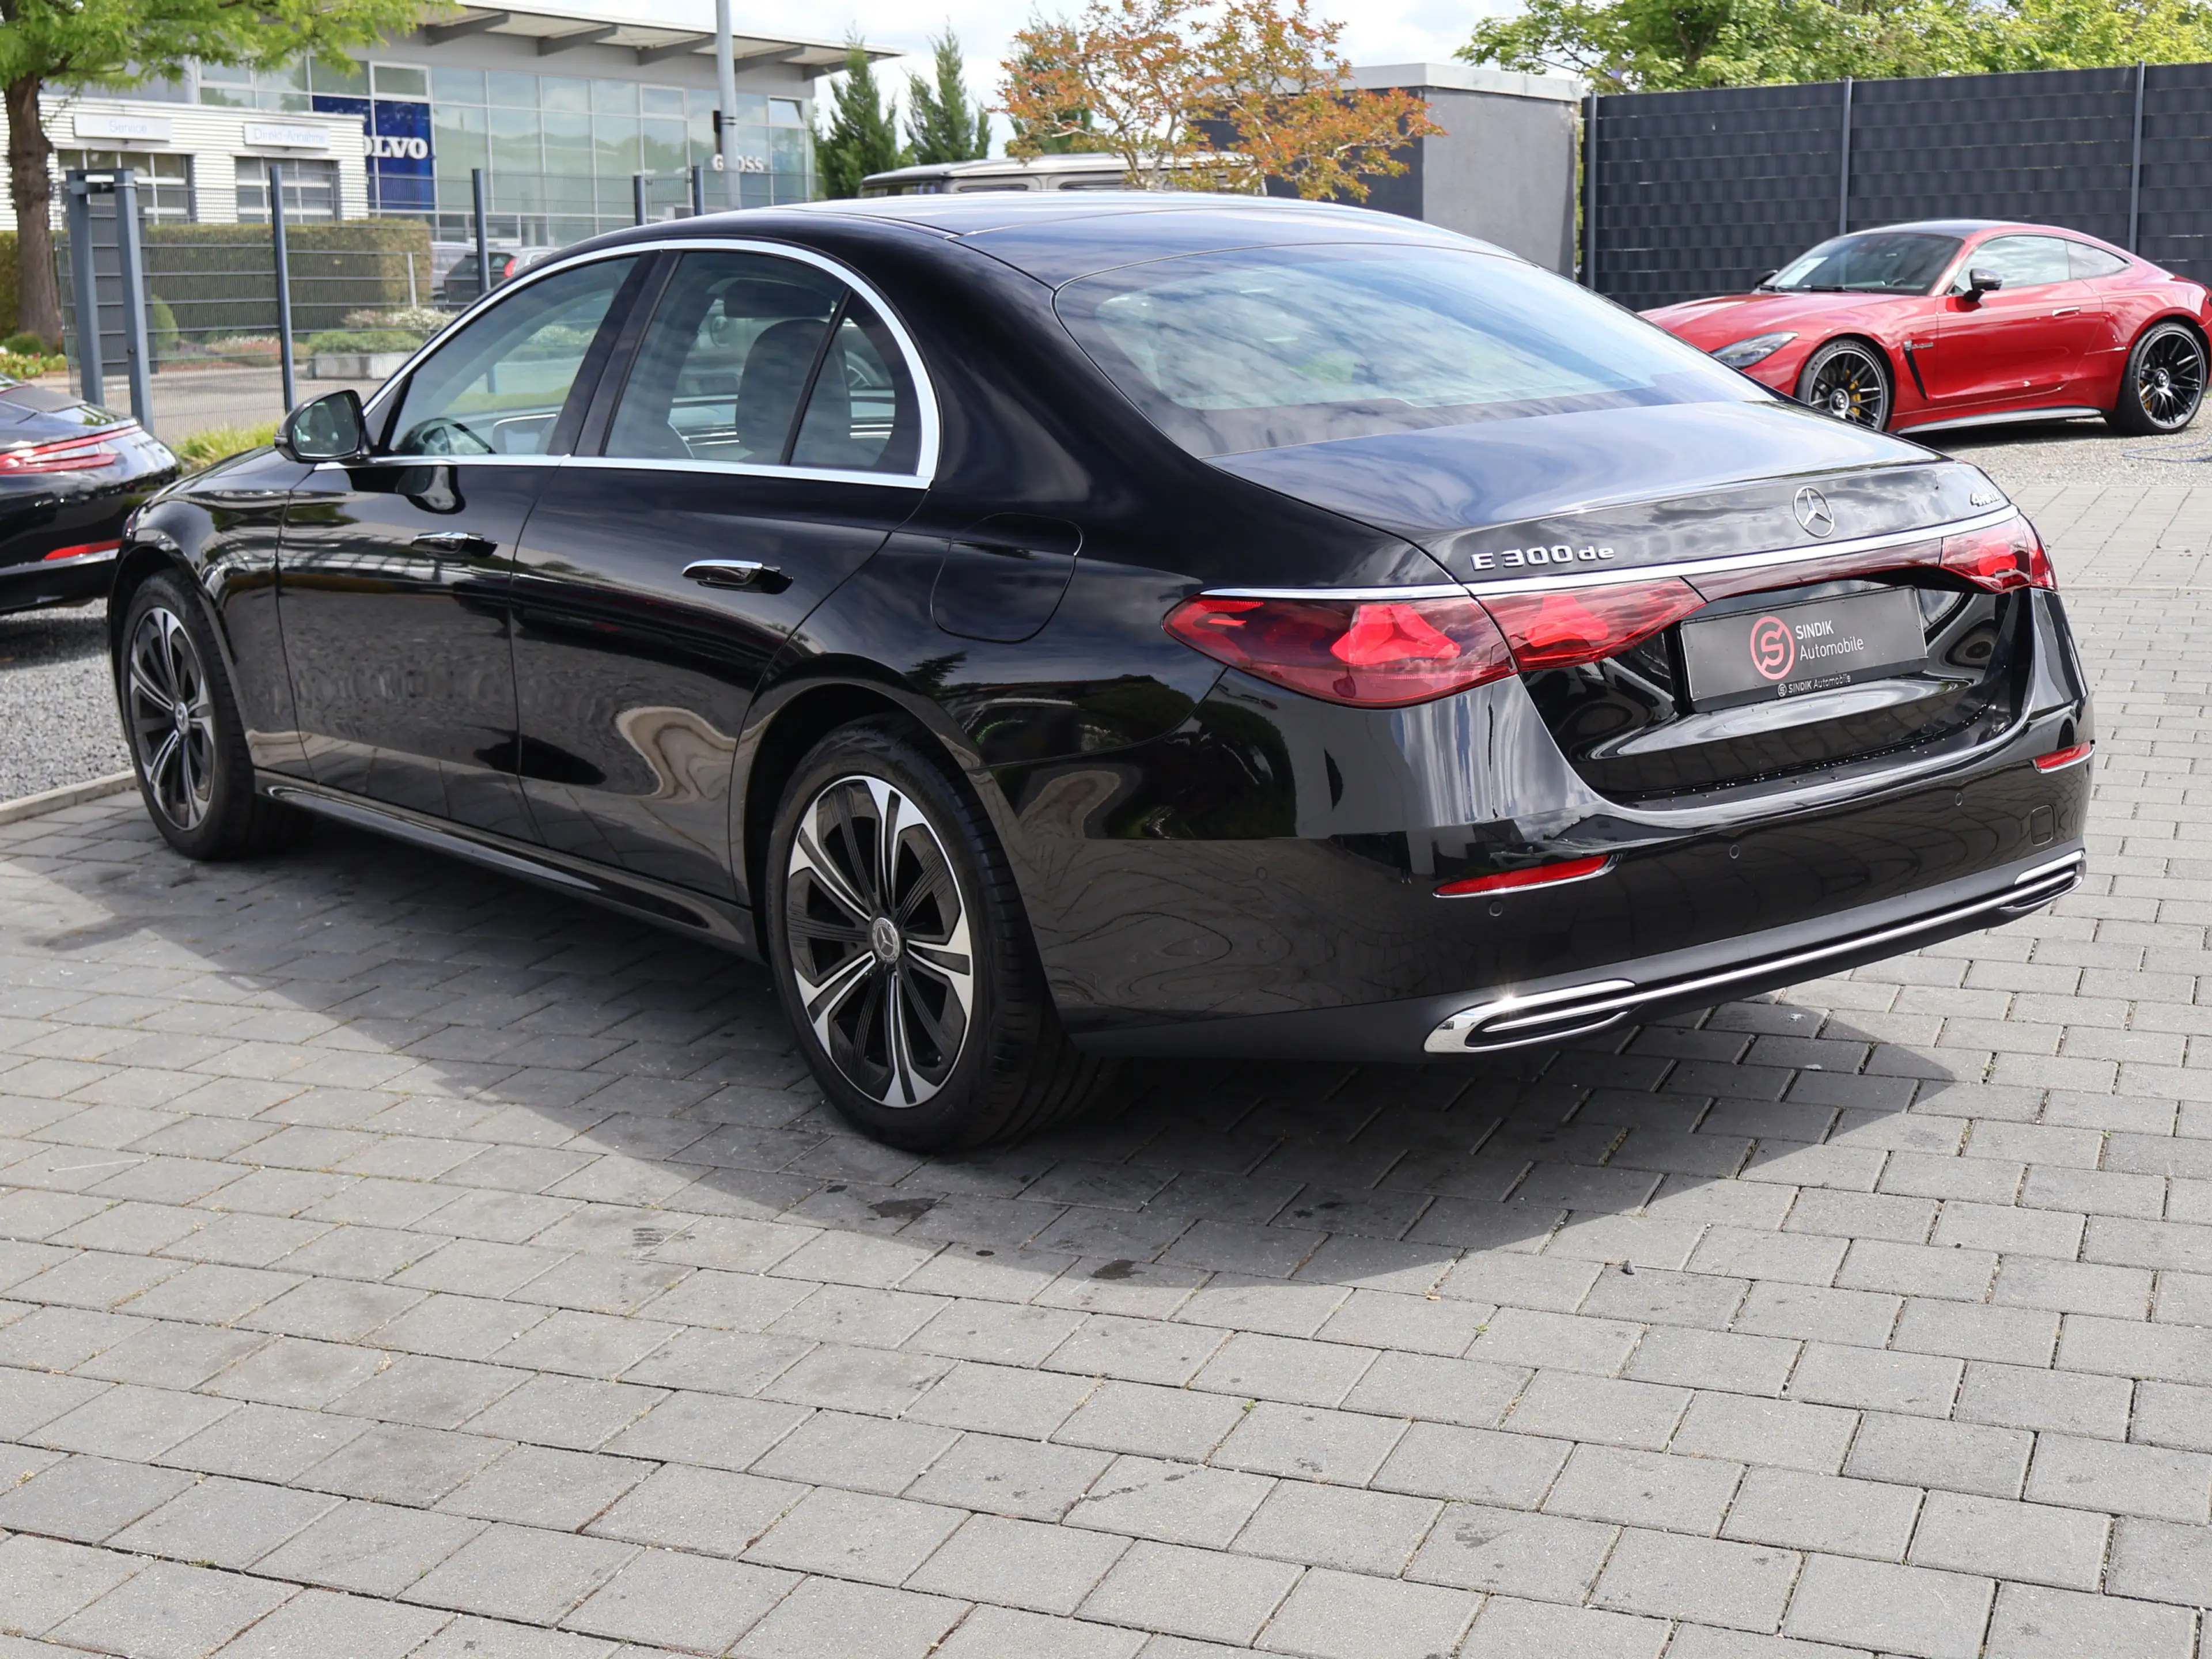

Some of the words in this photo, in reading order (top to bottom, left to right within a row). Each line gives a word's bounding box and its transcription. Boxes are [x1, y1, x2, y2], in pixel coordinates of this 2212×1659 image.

[712, 154, 764, 173] GOSS
[1796, 620, 1834, 640] SINDIK
[1800, 636, 1864, 661] Automobile
[1788, 680, 1812, 694] SINDIK
[1813, 673, 1851, 690] Automobile
